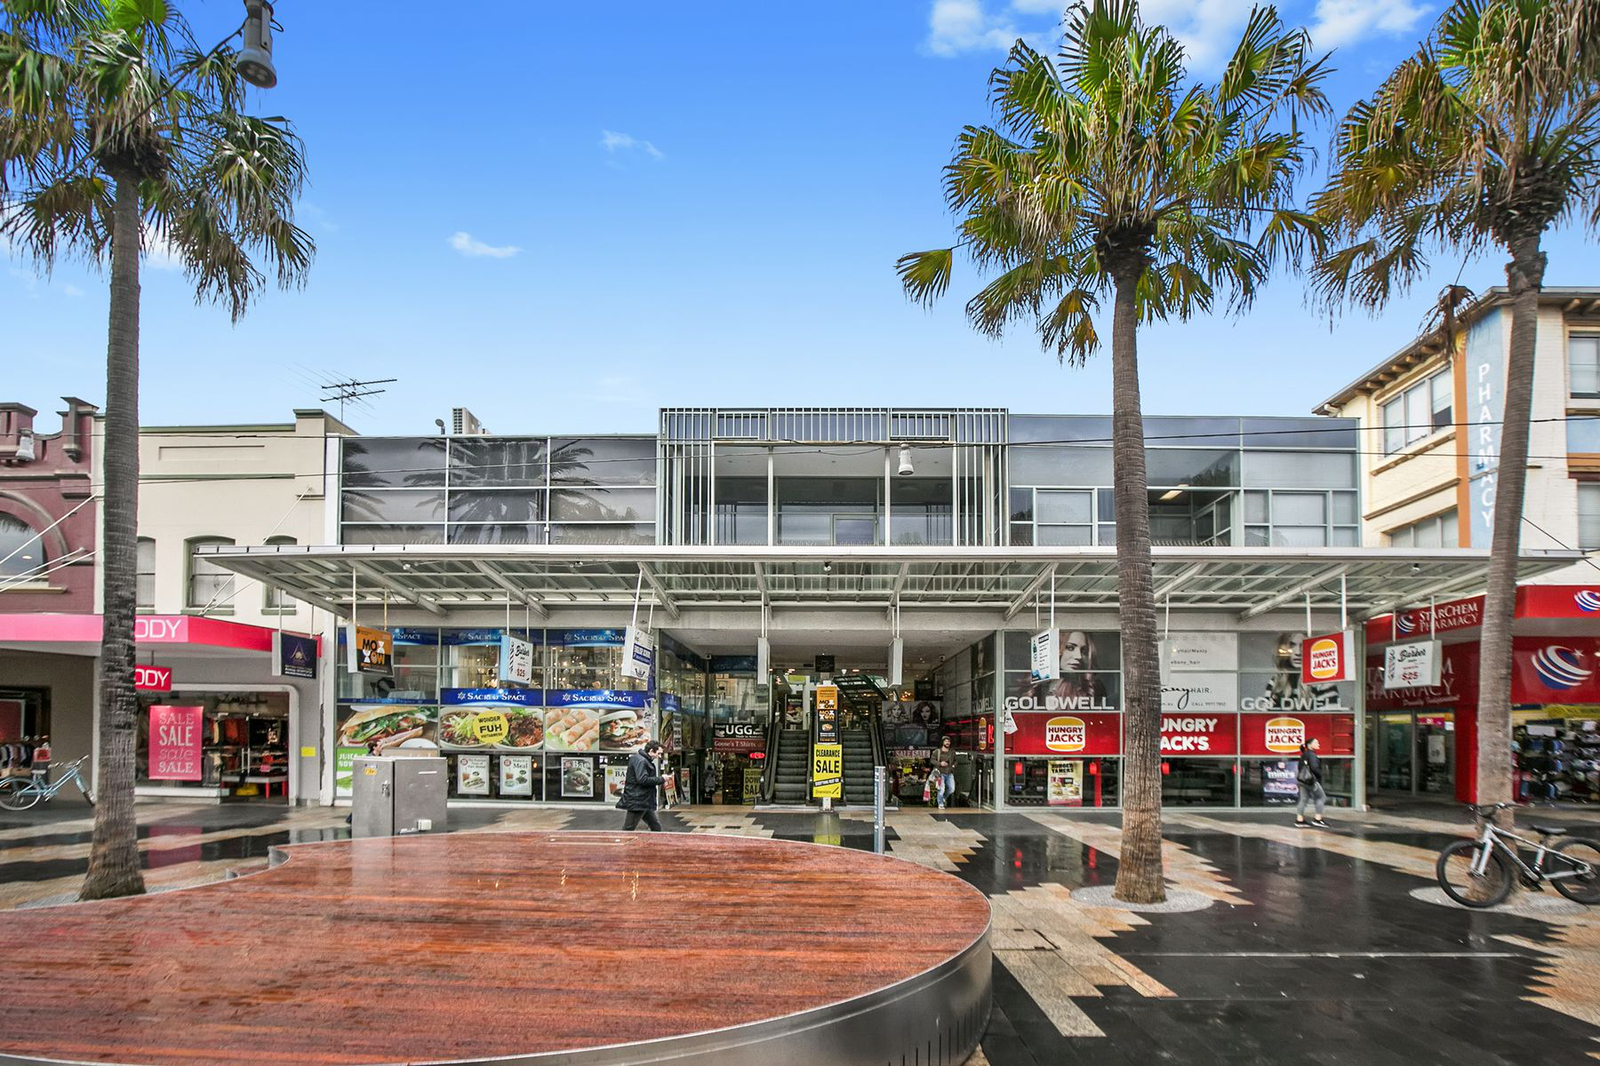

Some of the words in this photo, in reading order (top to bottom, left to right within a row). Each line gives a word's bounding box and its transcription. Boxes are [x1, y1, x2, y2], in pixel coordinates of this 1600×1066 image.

[1479, 362, 1495, 528] PHARMACY
[1420, 613, 1478, 632] PHARMACY
[1312, 651, 1336, 659] HUNGRY
[607, 694, 632, 702] SPACE
[1005, 696, 1115, 710] GOLDWELL
[1241, 697, 1349, 711] GOLDWELL
[159, 713, 194, 725] SALE
[477, 715, 501, 723] WONDER
[479, 724, 503, 733] FUH
[725, 725, 753, 735] UGG
[159, 726, 194, 747] SALE
[1048, 734, 1083, 743] JACK'S
[1267, 735, 1303, 744] JACK'S
[158, 748, 193, 761] sale
[815, 749, 841, 758] CLEARANCE
[815, 760, 840, 773] SALE
[745, 784, 760, 795] SAL
